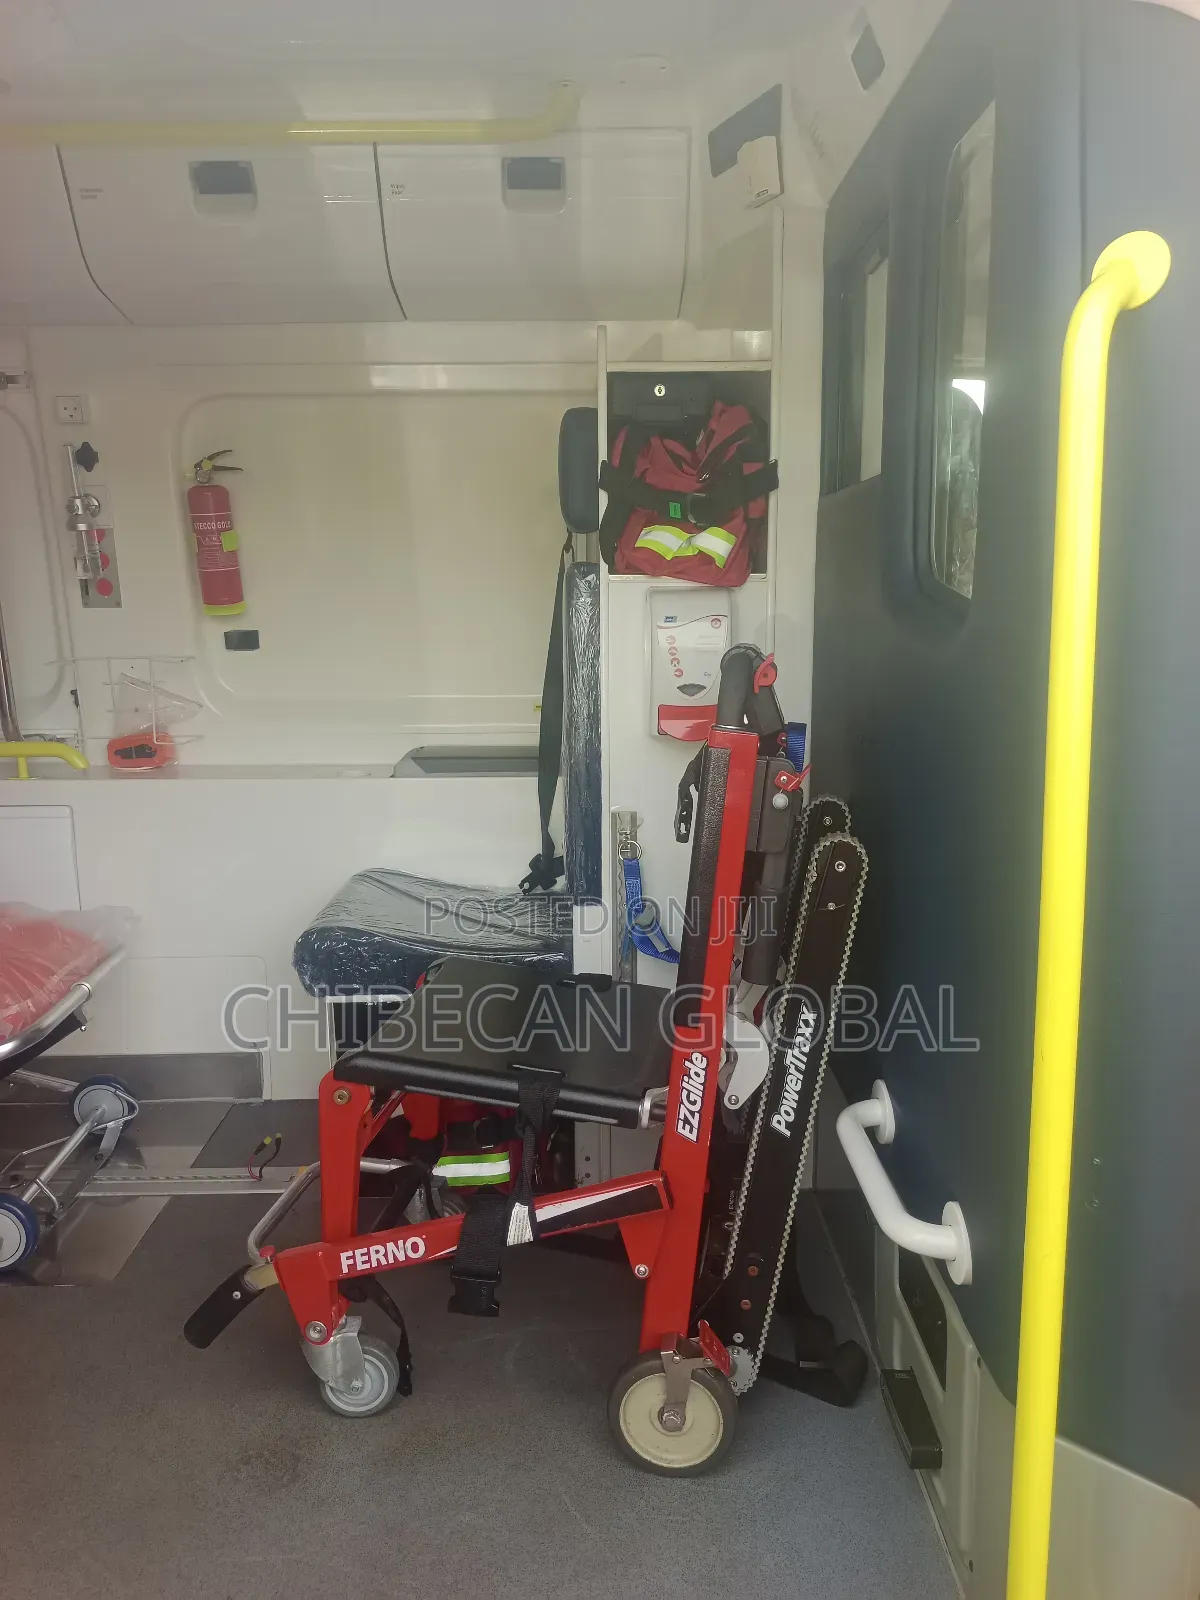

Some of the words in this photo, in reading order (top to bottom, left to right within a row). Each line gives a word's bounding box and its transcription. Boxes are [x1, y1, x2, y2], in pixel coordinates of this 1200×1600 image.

[675, 1050, 709, 1144] EZGlide
[770, 1002, 818, 1139] PowerTraxx
[339, 1235, 426, 1274] FERNO
